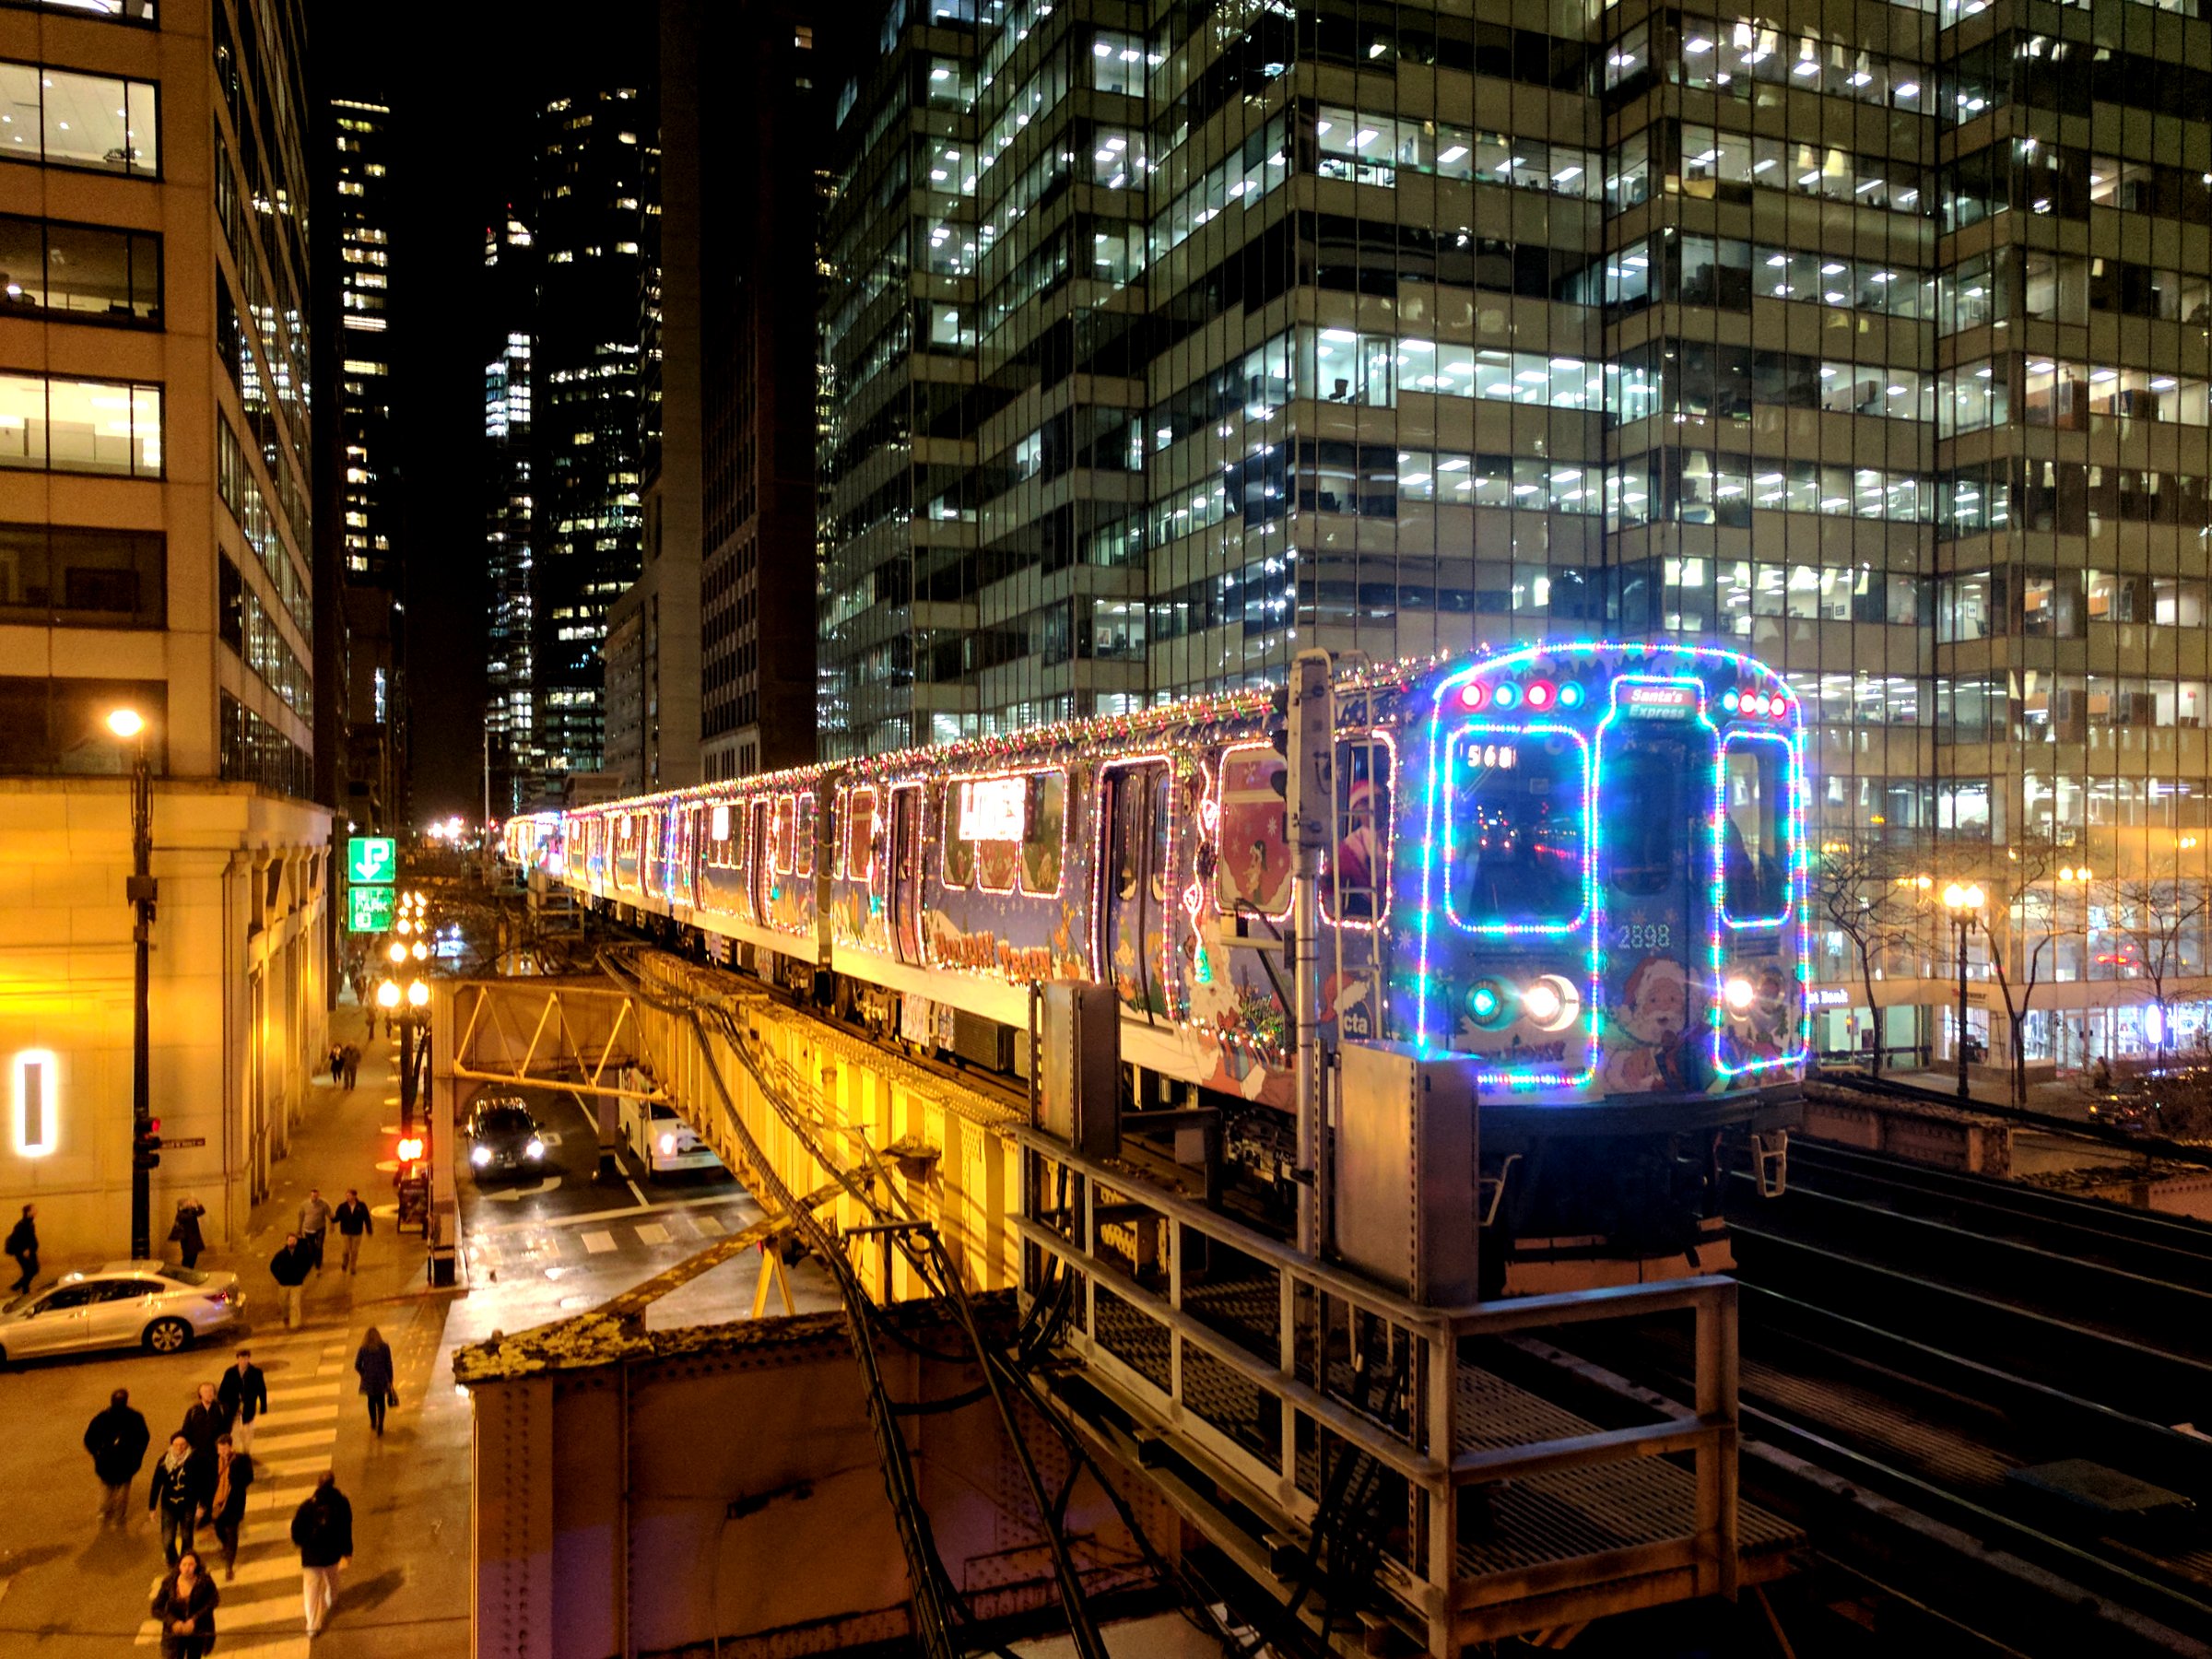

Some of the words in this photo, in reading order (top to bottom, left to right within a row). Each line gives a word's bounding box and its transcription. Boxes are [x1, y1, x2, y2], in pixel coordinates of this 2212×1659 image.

[1630, 688, 1684, 703] Santa's
[1629, 703, 1687, 720] Express
[1618, 924, 1670, 949] 2898
[1820, 988, 1849, 1004] Bank
[1343, 1013, 1368, 1034] cta
